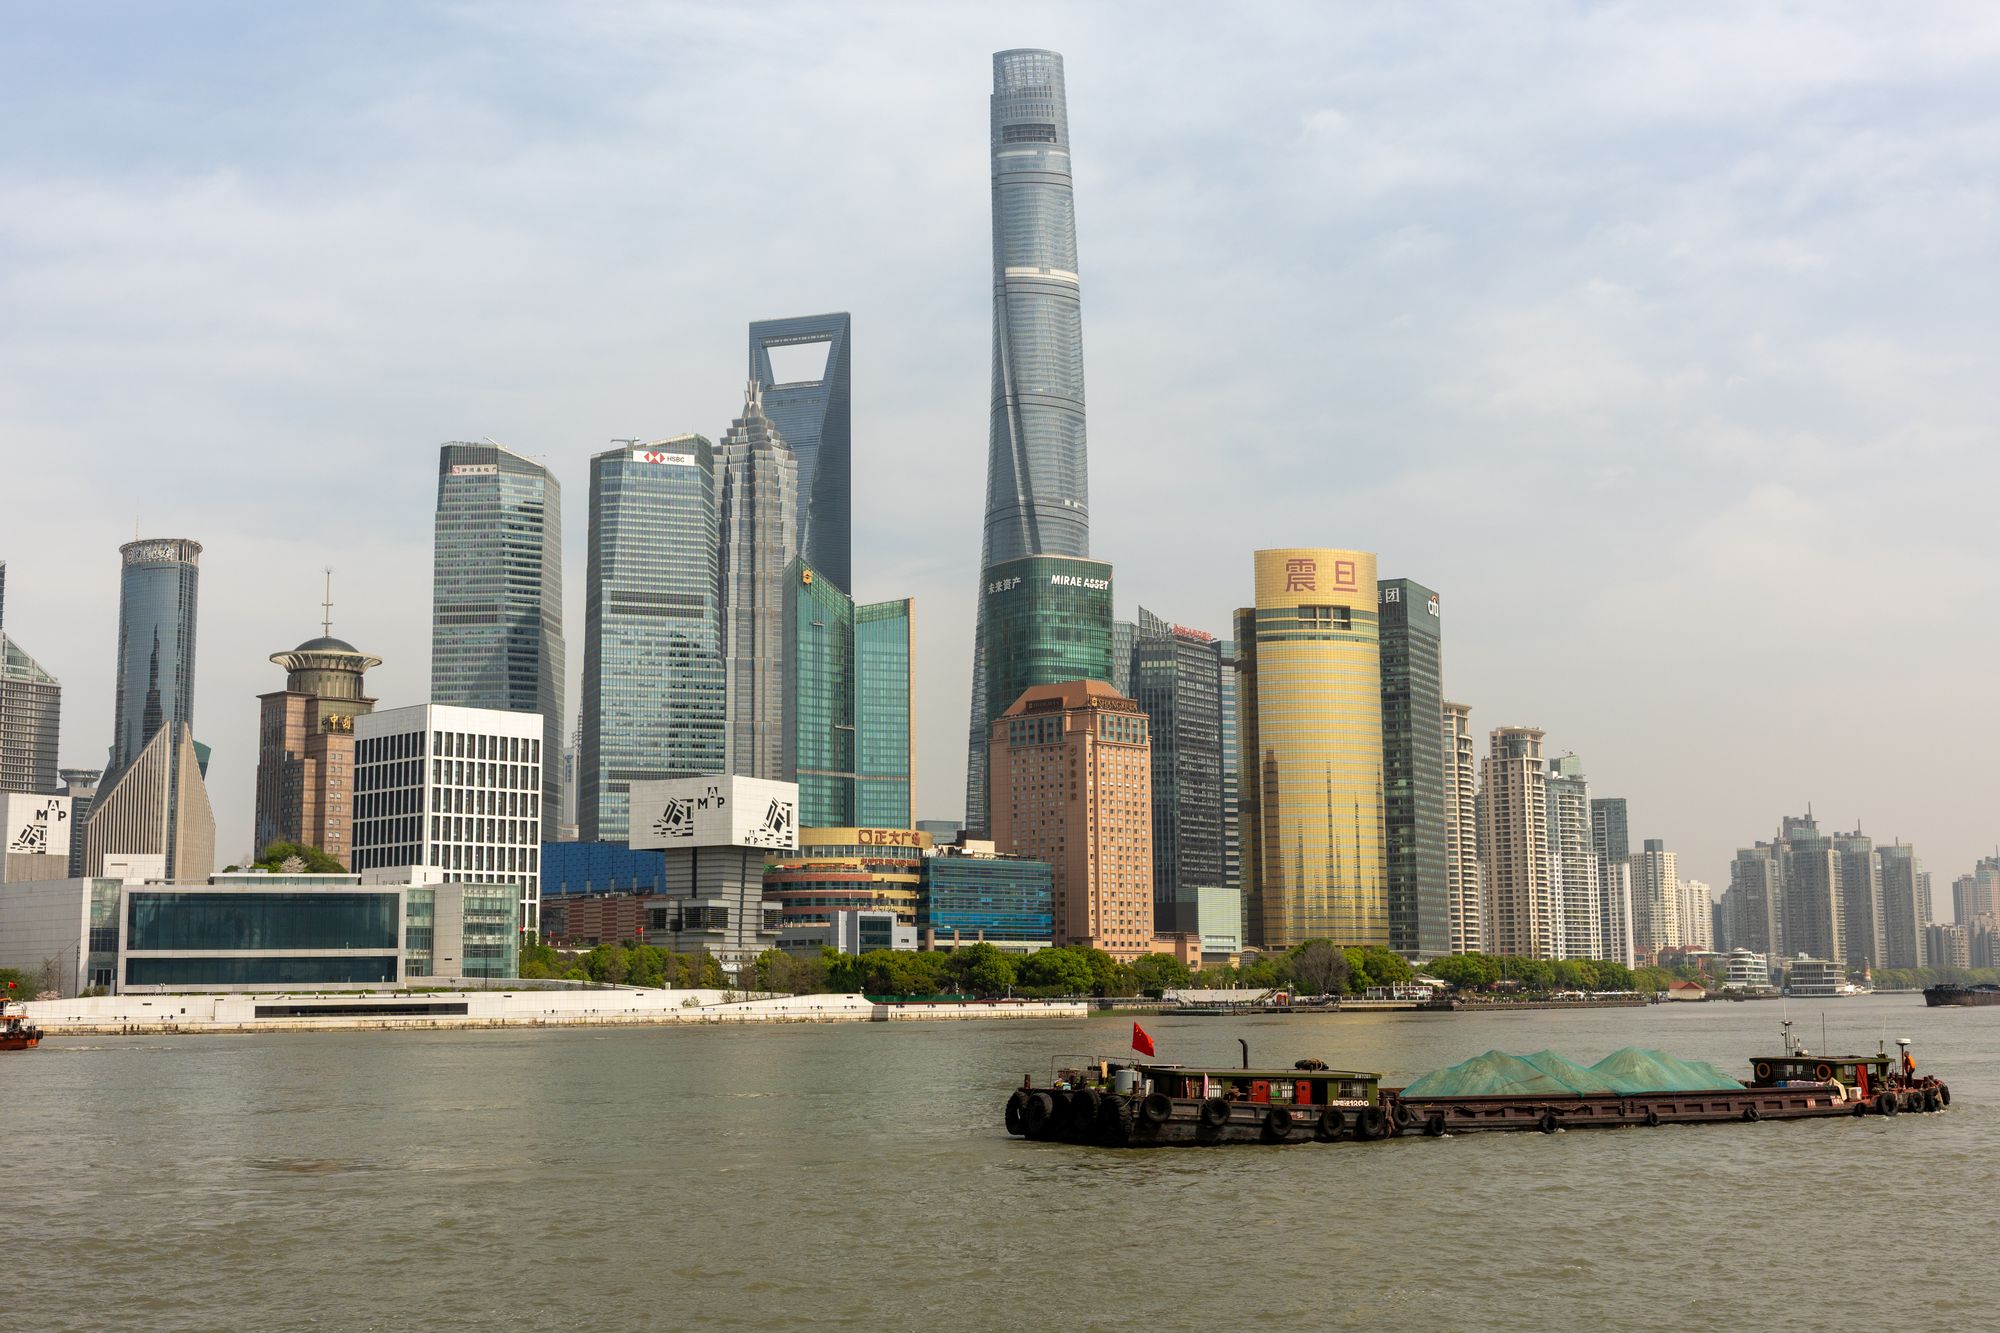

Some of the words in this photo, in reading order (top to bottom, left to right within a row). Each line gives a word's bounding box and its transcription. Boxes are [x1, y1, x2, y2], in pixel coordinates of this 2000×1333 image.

[666, 455, 685, 463] HSBC
[1051, 574, 1082, 587] MIRAE
[1083, 578, 1109, 590] ASSET
[1285, 558, 1358, 592] 震旦
[988, 577, 1021, 594] 未来资产
[697, 786, 725, 809] MAP
[36, 799, 67, 821] MAP
[874, 830, 920, 846] 正大广场
